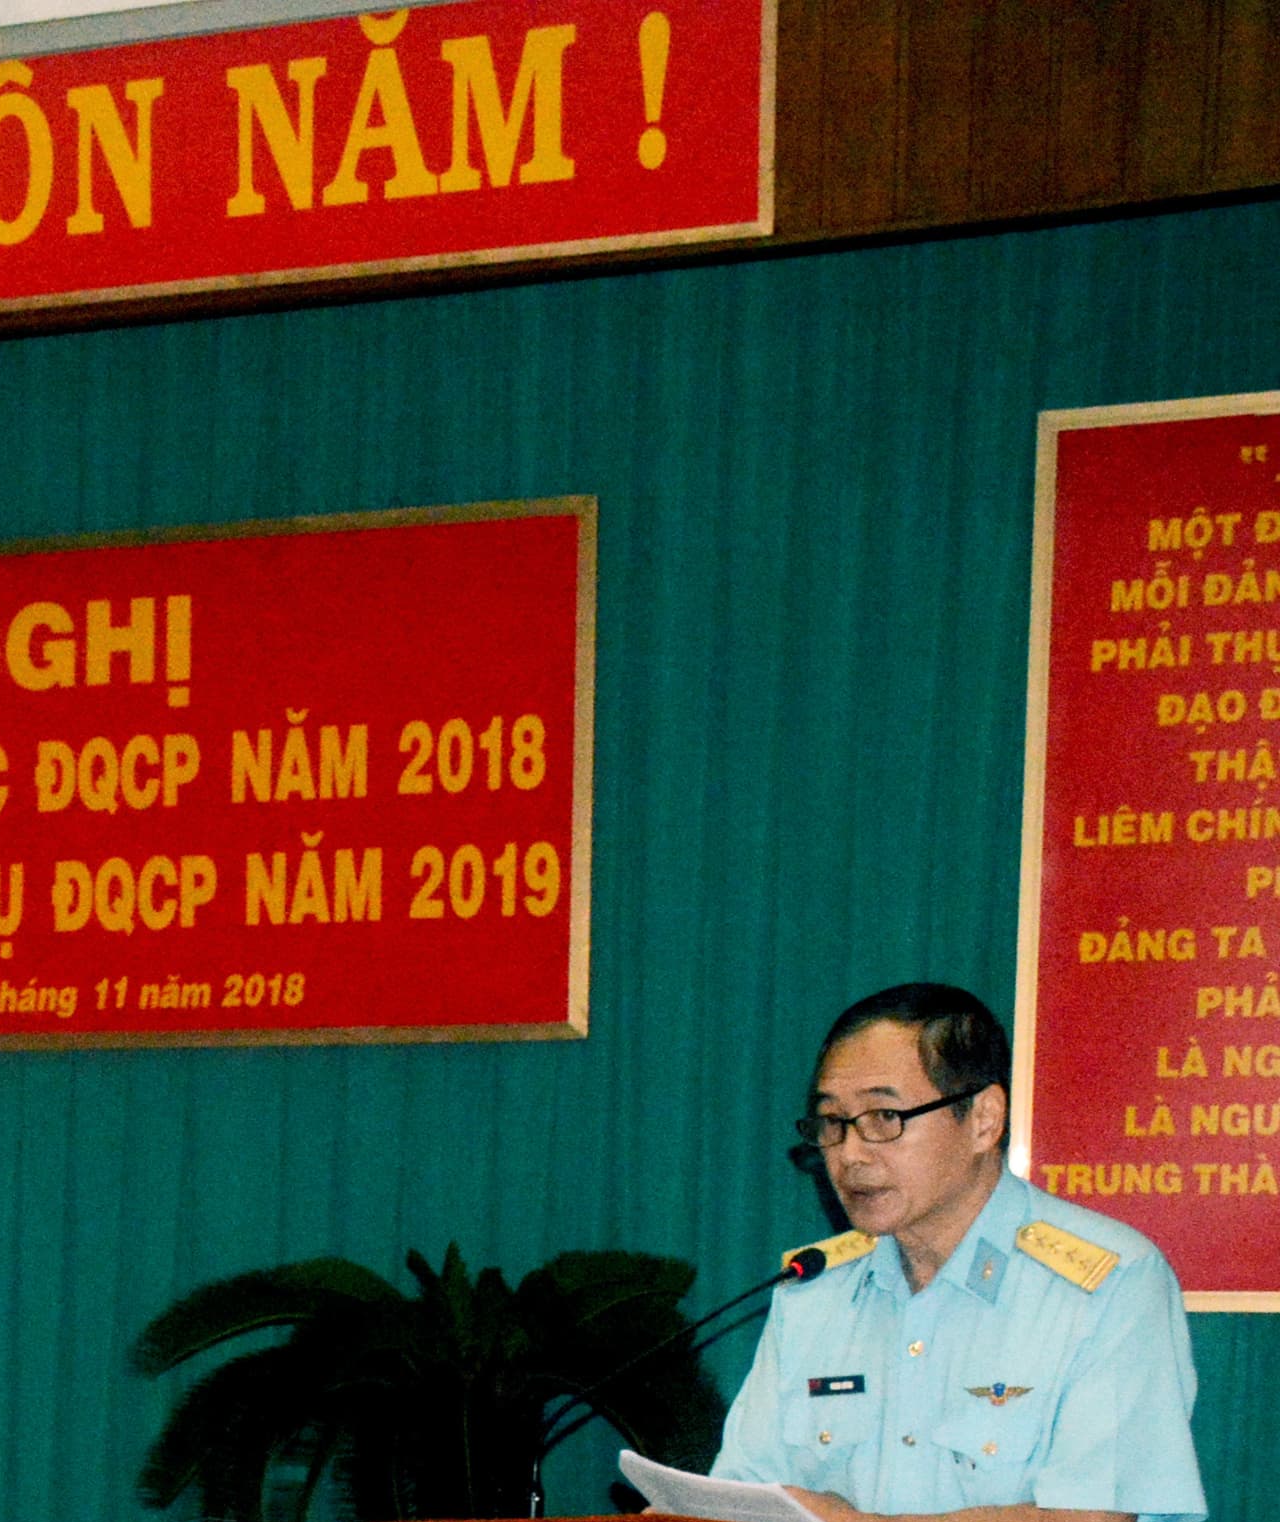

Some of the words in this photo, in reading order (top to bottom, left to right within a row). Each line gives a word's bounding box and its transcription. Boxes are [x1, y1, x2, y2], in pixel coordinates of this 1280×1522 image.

[226, 10, 578, 219] NĂM
[636, 12, 673, 170] !
[1148, 506, 1242, 560] MỘT
[1110, 559, 1189, 612] MỖI
[1091, 620, 1191, 672] PHẢI
[1158, 690, 1247, 734] ĐẠO
[35, 734, 200, 815] ĐQCP
[231, 709, 369, 802] NĂM
[398, 713, 547, 795] 2018
[1073, 805, 1174, 848] LIÊM
[52, 853, 218, 937] ĐQCP
[244, 831, 383, 927] NĂM
[409, 840, 561, 920] 2019
[1079, 915, 1196, 964] ĐẢNG
[1211, 925, 1267, 959] TA
[94, 976, 129, 1010] 11
[140, 974, 211, 1010] năm
[223, 972, 306, 1007] 2018
[1155, 1035, 1208, 1078] LÀ
[1125, 1096, 1176, 1137] LÀ
[1041, 1162, 1184, 1196] TRUNG
